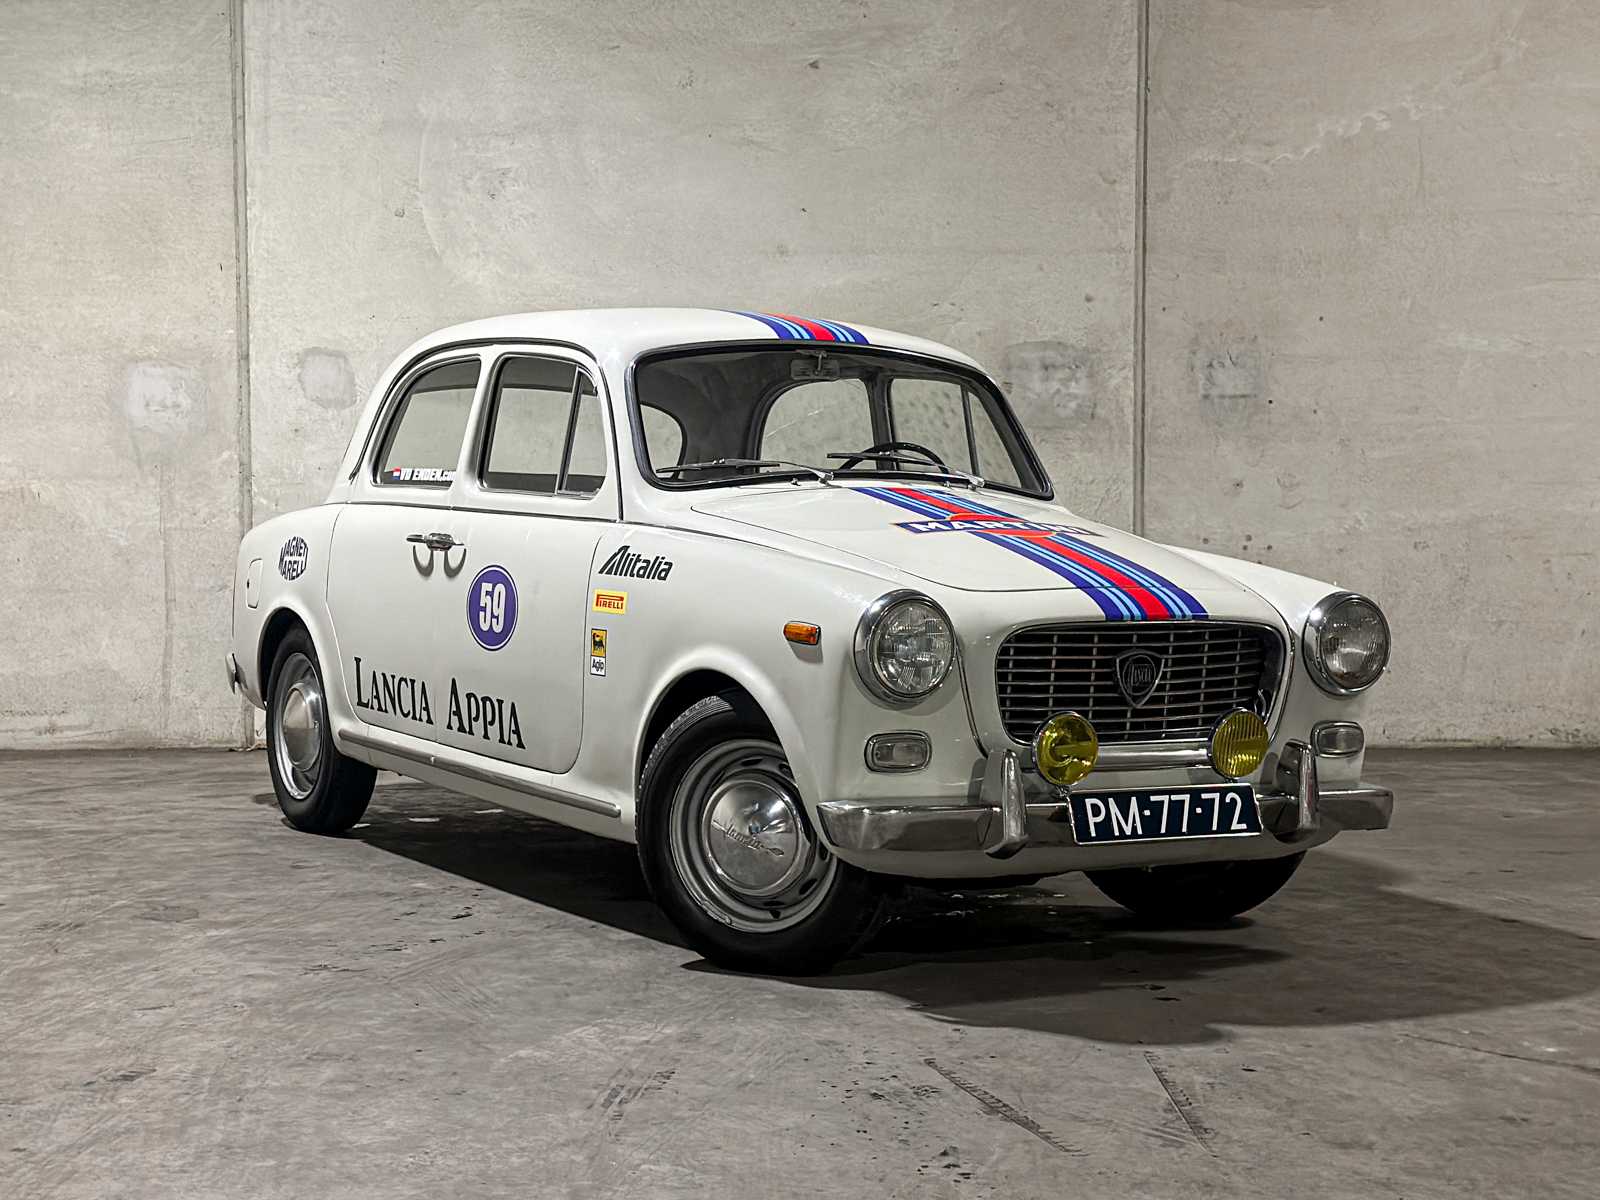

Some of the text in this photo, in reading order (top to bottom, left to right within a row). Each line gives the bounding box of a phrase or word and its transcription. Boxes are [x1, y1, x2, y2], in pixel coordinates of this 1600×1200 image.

[909, 520, 1092, 537] MARTINI
[598, 545, 674, 581] Alitalia
[479, 582, 506, 634] 59
[595, 593, 625, 610] PIRELLI
[354, 656, 526, 750] LANCIA APPIA
